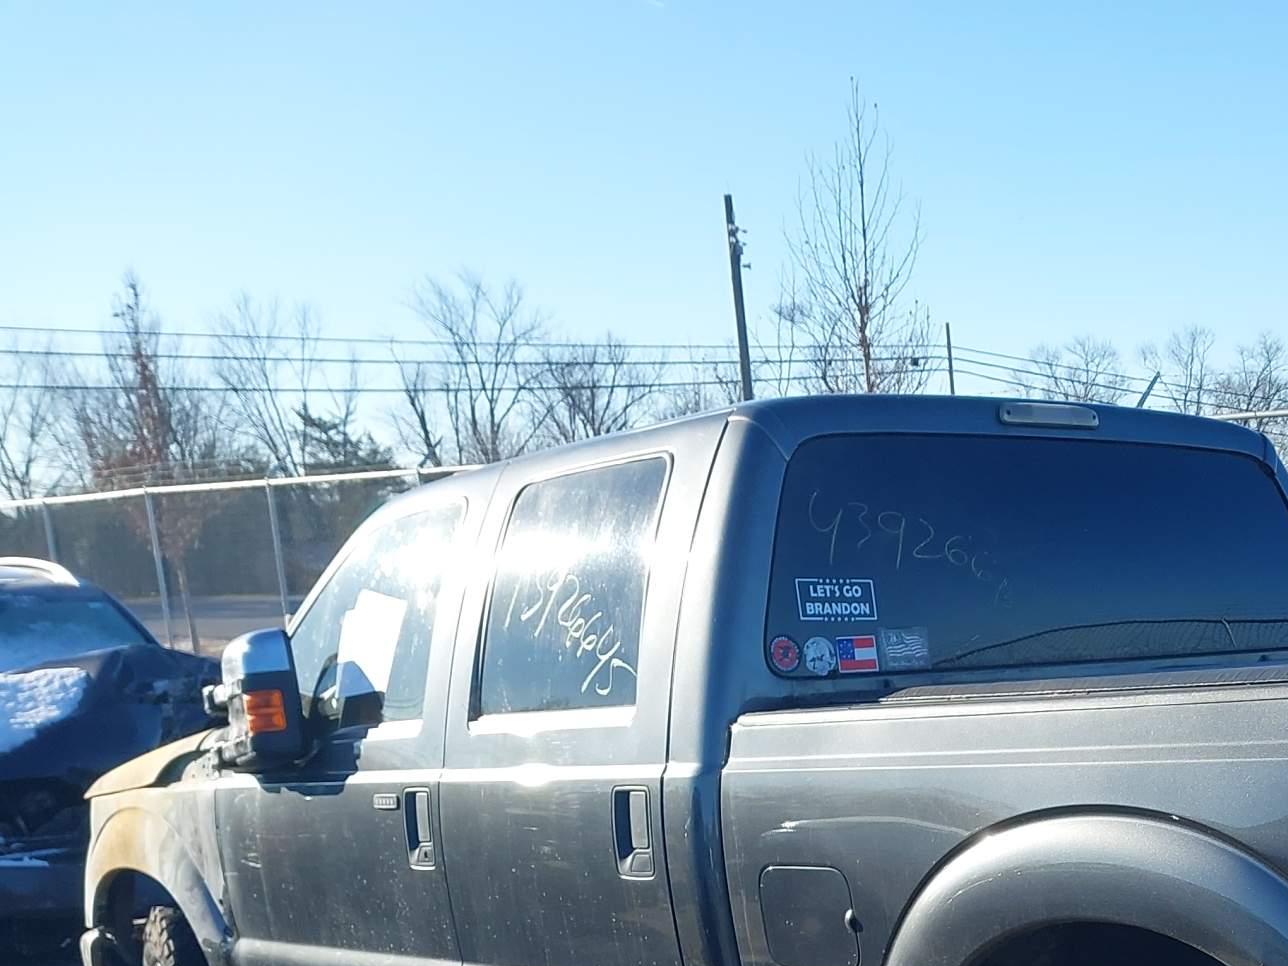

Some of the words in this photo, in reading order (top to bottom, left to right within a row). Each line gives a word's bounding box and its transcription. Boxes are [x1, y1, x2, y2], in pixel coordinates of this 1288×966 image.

[809, 584, 840, 598] LET'S
[842, 585, 862, 598] GO
[805, 602, 871, 616] BRANDON
